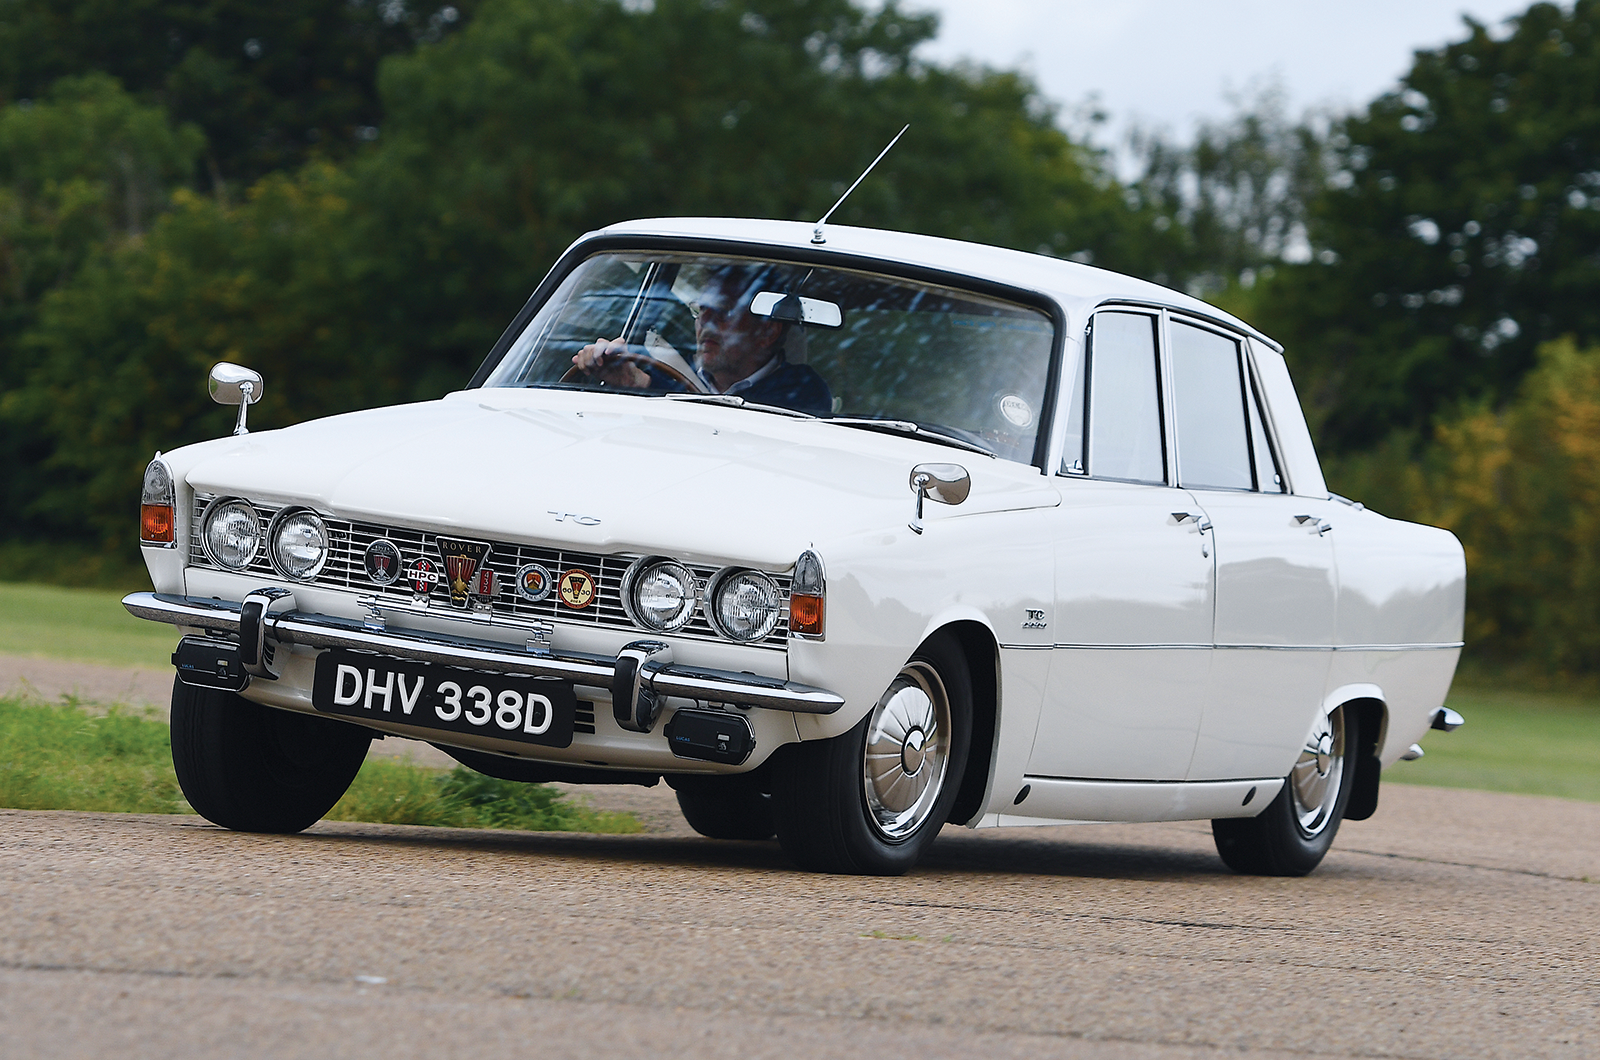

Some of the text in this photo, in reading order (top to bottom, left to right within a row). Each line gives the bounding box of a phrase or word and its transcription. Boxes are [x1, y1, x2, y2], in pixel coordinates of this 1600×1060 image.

[442, 541, 482, 554] ROVER
[408, 570, 437, 582] HPC
[1025, 608, 1045, 620] TC
[334, 664, 553, 735] DHV 338D
